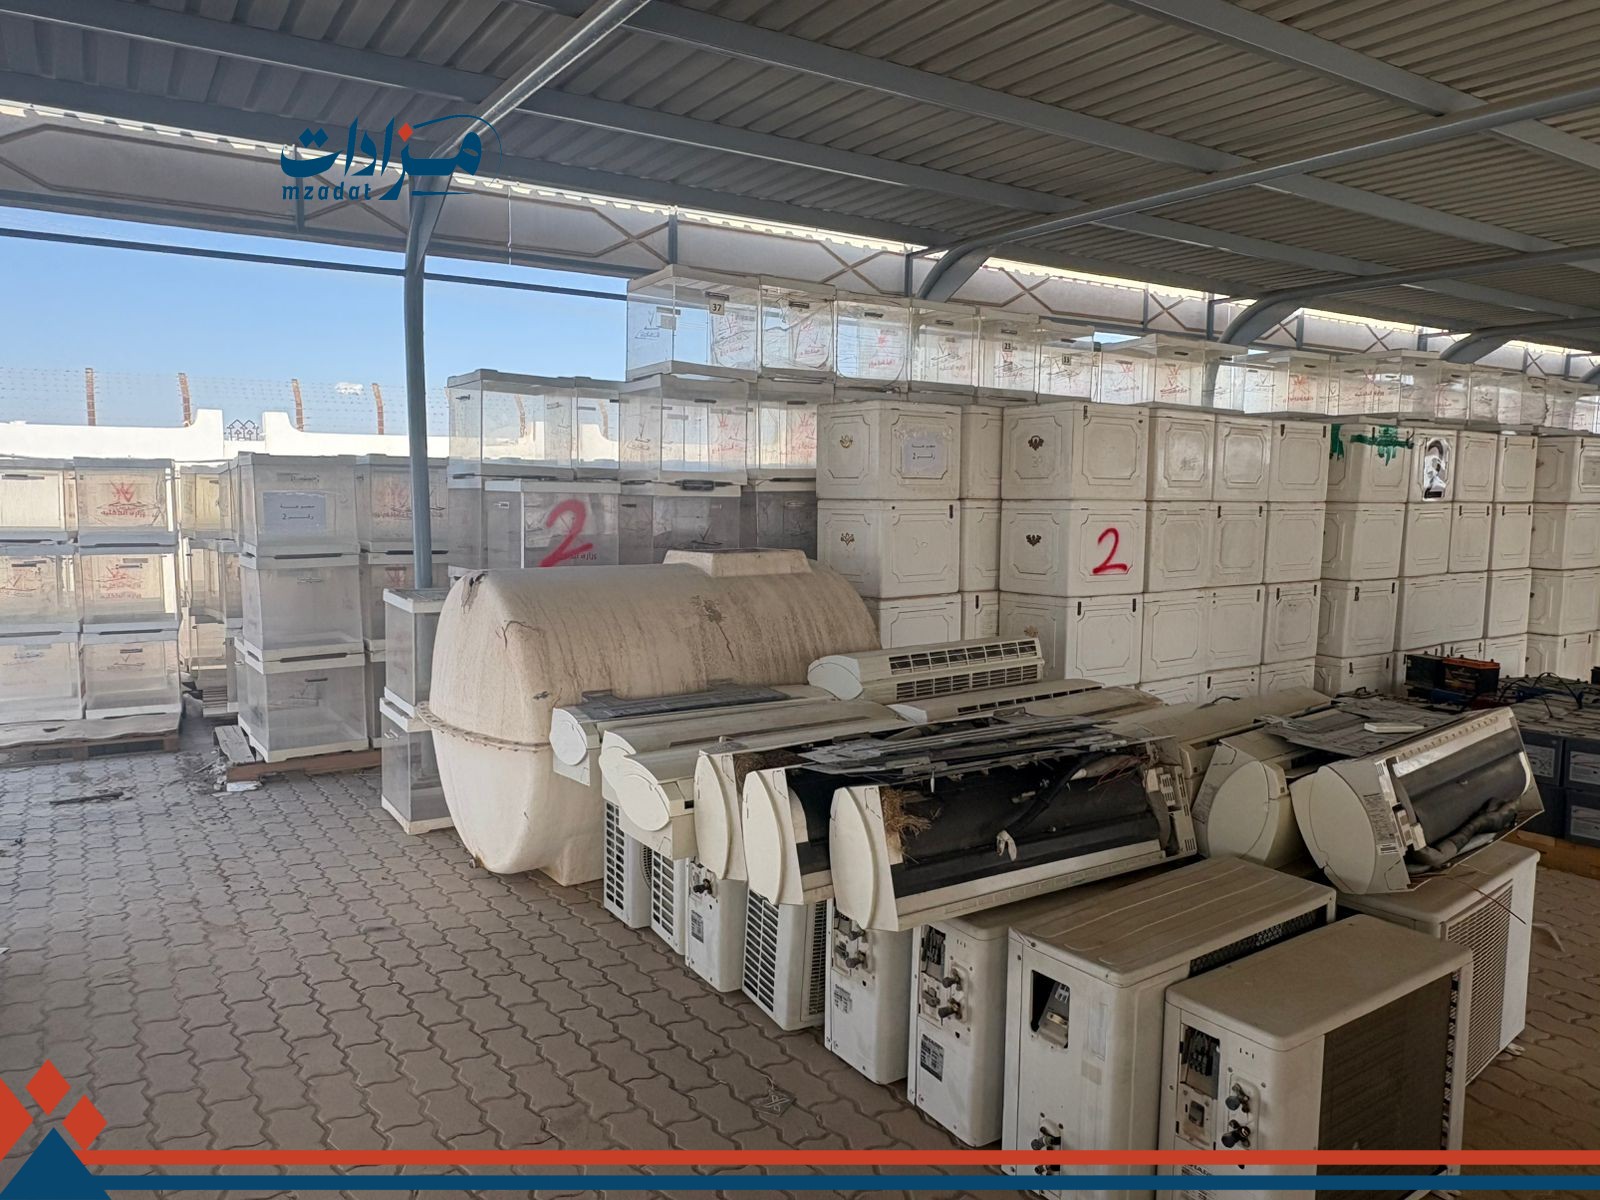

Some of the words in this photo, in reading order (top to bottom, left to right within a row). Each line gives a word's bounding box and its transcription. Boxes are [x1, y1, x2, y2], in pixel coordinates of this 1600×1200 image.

[711, 303, 723, 313] 37
[537, 498, 594, 568] 2
[1092, 527, 1128, 574] 2
